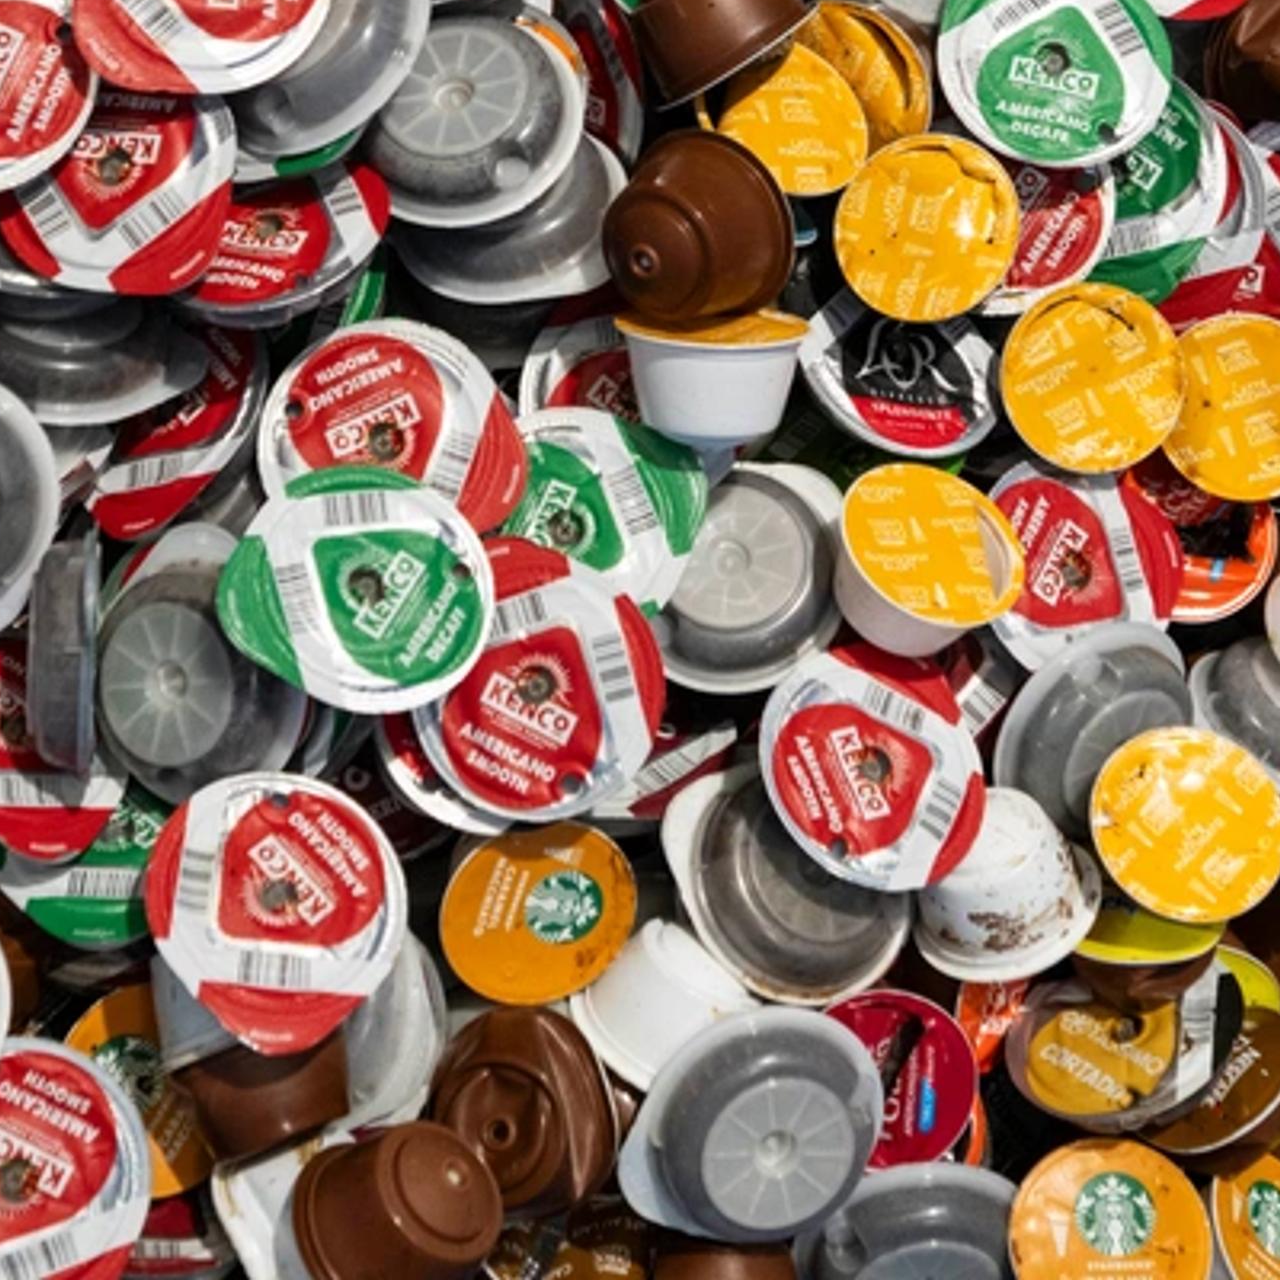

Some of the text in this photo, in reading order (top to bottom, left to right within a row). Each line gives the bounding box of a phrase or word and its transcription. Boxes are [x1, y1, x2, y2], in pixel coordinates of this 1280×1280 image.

[10, 45, 61, 139] AMERICANO
[37, 71, 70, 129] SMOOTH
[997, 103, 1090, 131] AMERICANO
[1012, 122, 1069, 141] DECAFF
[1024, 194, 1080, 271] AMERICANO
[1050, 219, 1082, 265] SMOOTH
[309, 359, 403, 410] AMERICANO
[316, 350, 378, 384] SMOOTH
[402, 584, 458, 666] AMERICANO
[428, 609, 466, 662] DECAFF
[460, 724, 554, 782] AMERICANO
[468, 751, 529, 792] SMOOTH
[788, 758, 821, 818] SMOOTH
[795, 738, 843, 832] AMERICANO
[289, 814, 368, 896] AMERICANO
[319, 813, 369, 871] SMOOTH
[26, 1072, 90, 1111] SMOOTH
